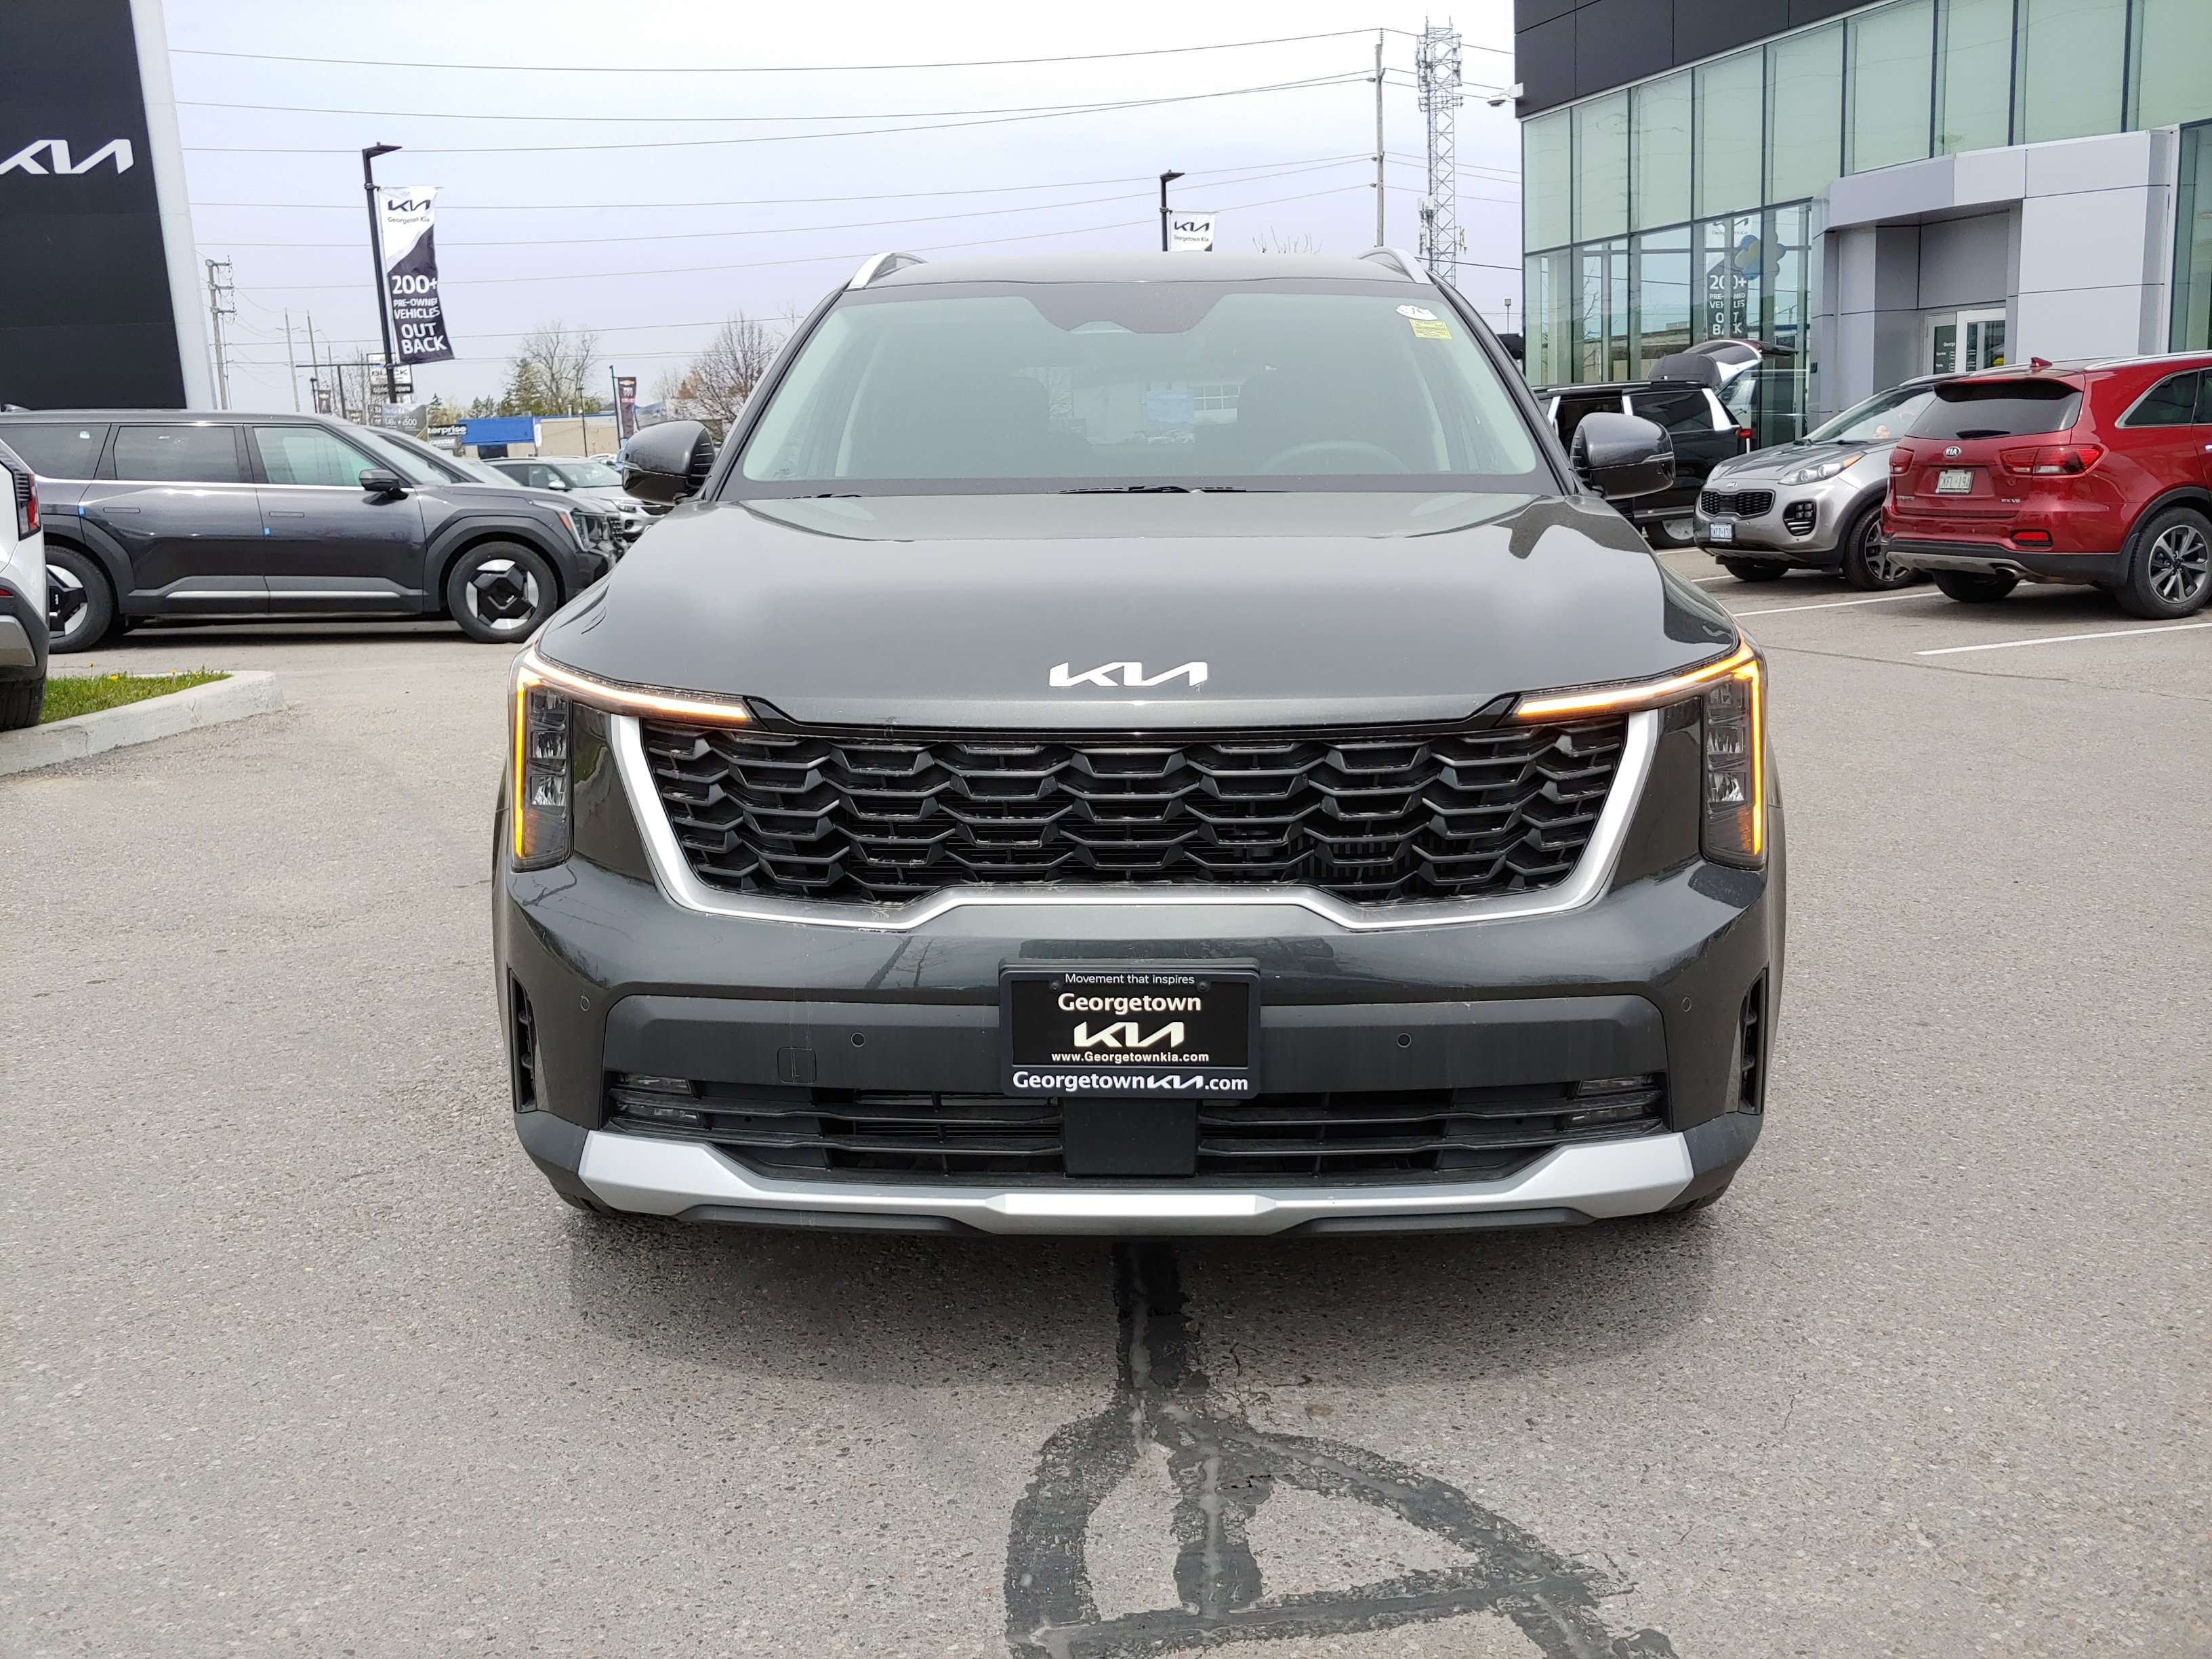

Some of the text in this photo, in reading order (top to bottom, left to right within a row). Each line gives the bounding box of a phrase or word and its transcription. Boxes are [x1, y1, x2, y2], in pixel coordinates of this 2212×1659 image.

[388, 199, 431, 211] KIA
[1174, 221, 1210, 232] KIA
[391, 274, 438, 294] 200+
[394, 306, 441, 319] VEHICLES
[1715, 312, 1739, 323] OT
[401, 322, 436, 339] OUT
[401, 335, 448, 354] BACK
[1049, 661, 1208, 687] KIA
[1065, 973, 1195, 986] Movement that inspires
[1058, 992, 1202, 1015] Georgetown
[1073, 1021, 1185, 1048] KIA
[1051, 1051, 1210, 1065] www.Georgetownkia.com
